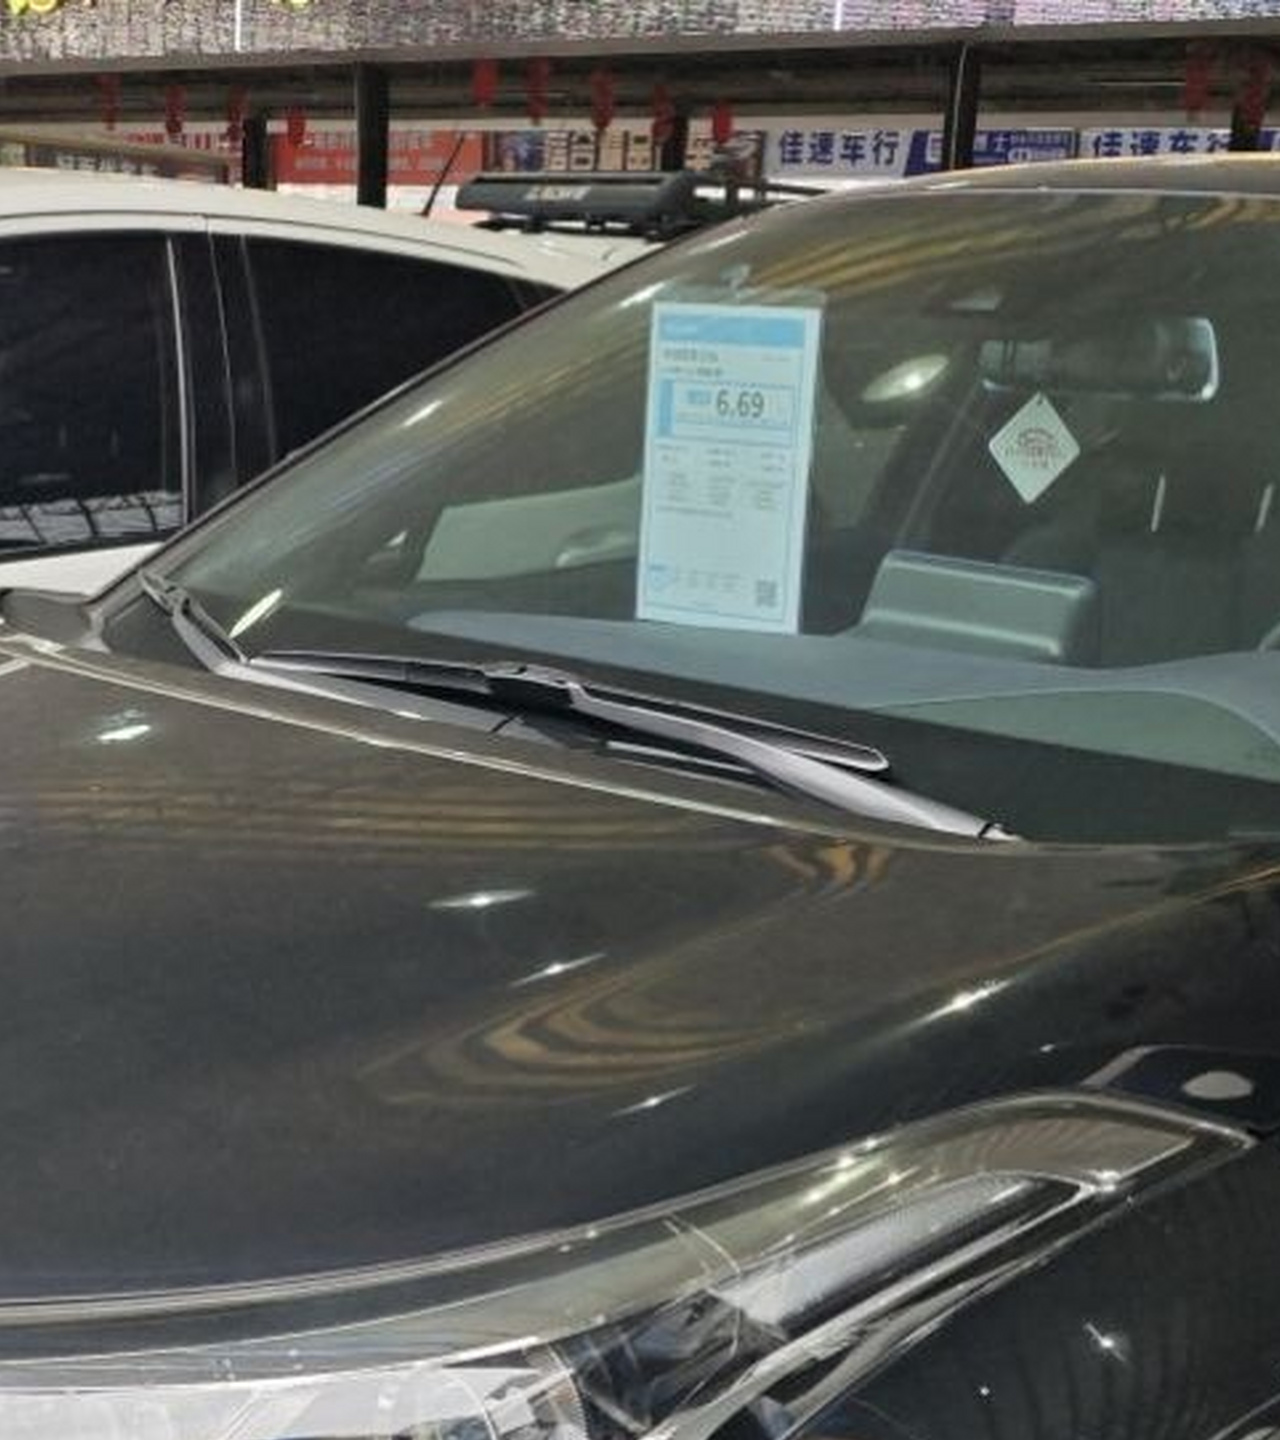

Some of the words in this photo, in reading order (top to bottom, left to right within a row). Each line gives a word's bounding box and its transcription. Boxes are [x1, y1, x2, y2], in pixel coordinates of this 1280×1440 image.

[779, 130, 900, 166] 佳速车行
[716, 389, 764, 418] 6.69
